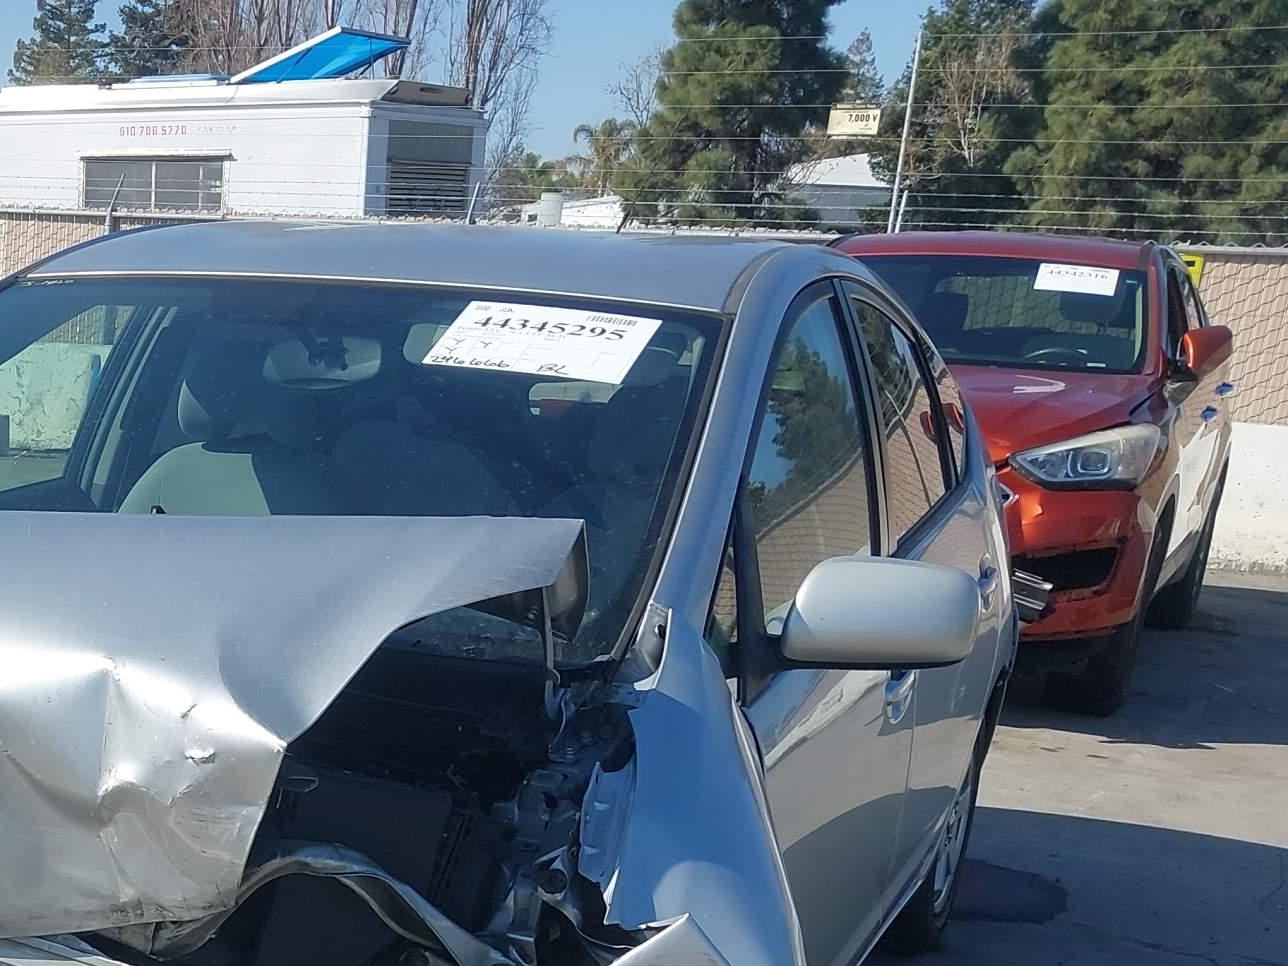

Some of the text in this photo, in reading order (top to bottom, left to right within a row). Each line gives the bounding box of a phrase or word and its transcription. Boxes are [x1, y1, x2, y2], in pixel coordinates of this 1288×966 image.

[848, 114, 878, 124] 7,000 V
[161, 124, 187, 136] 5770
[474, 314, 627, 342] 44345295
